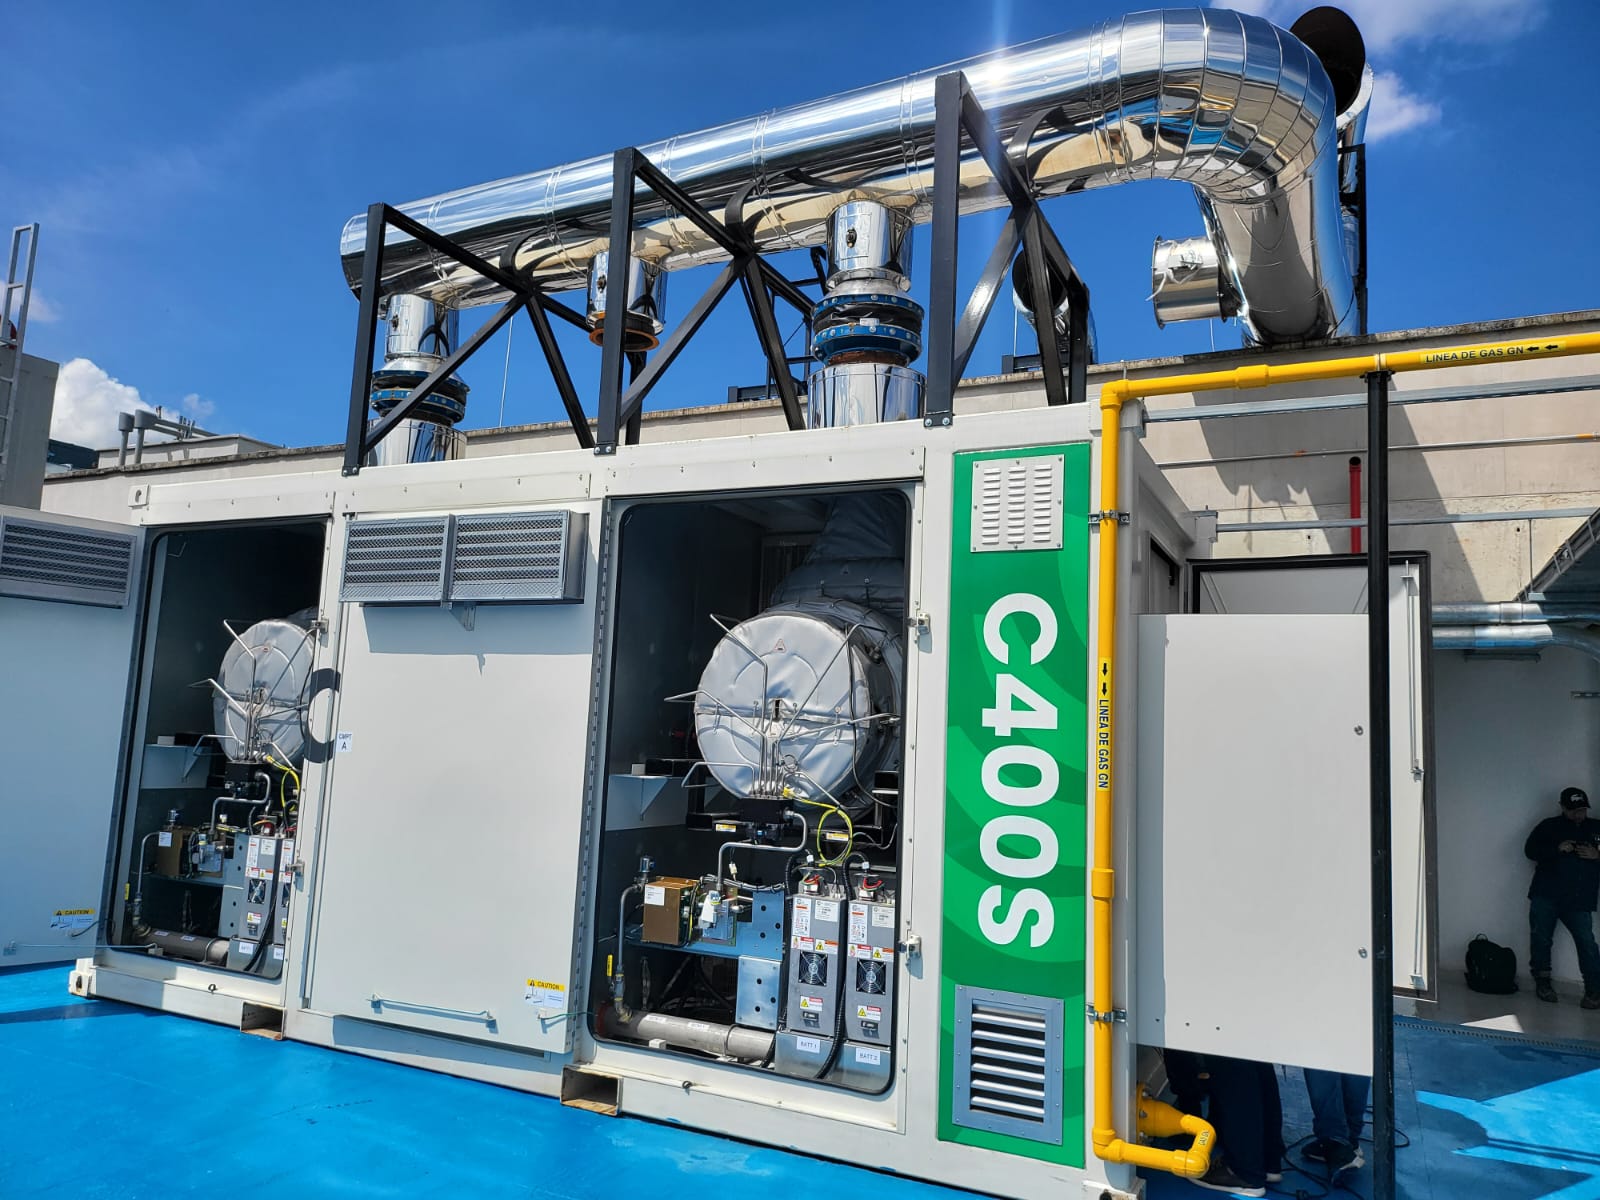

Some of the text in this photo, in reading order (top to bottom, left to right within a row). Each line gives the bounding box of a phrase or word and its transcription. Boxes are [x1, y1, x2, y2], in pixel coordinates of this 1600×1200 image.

[1426, 346, 1524, 363] LINEA DE GAS GN
[341, 741, 347, 750] A
[1098, 699, 1109, 788] LINEA DE GAS GN
[978, 592, 1060, 948] C400S
[537, 980, 560, 990] CAUTION
[800, 1040, 813, 1048] BATT
[860, 1052, 872, 1060] BATT
